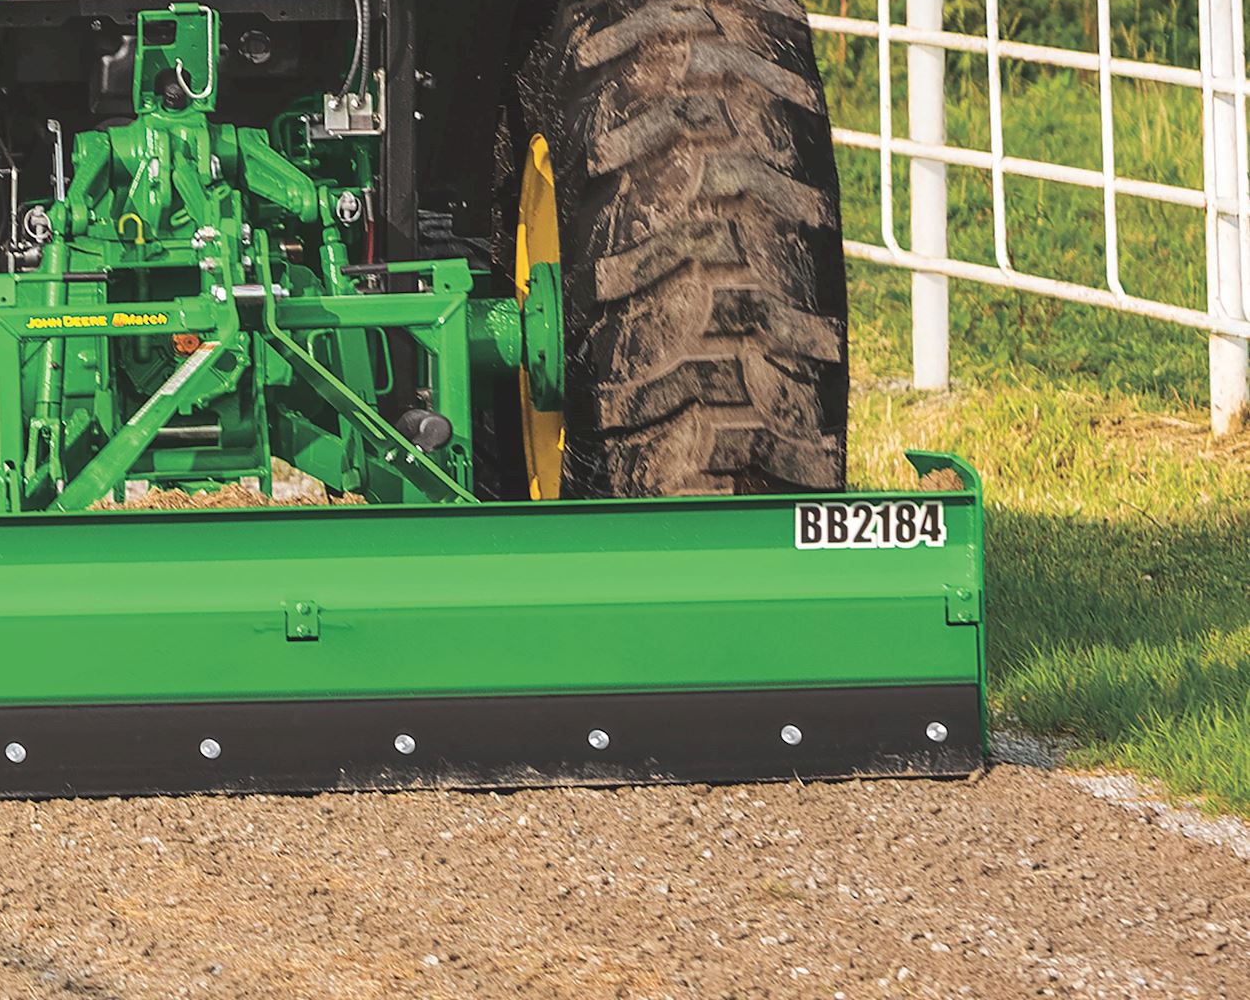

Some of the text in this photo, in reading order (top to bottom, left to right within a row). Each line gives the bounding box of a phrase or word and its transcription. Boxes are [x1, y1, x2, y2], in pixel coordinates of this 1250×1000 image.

[26, 317, 62, 328] JOHN
[62, 315, 107, 327] DEERE
[797, 502, 944, 547] BB2184
